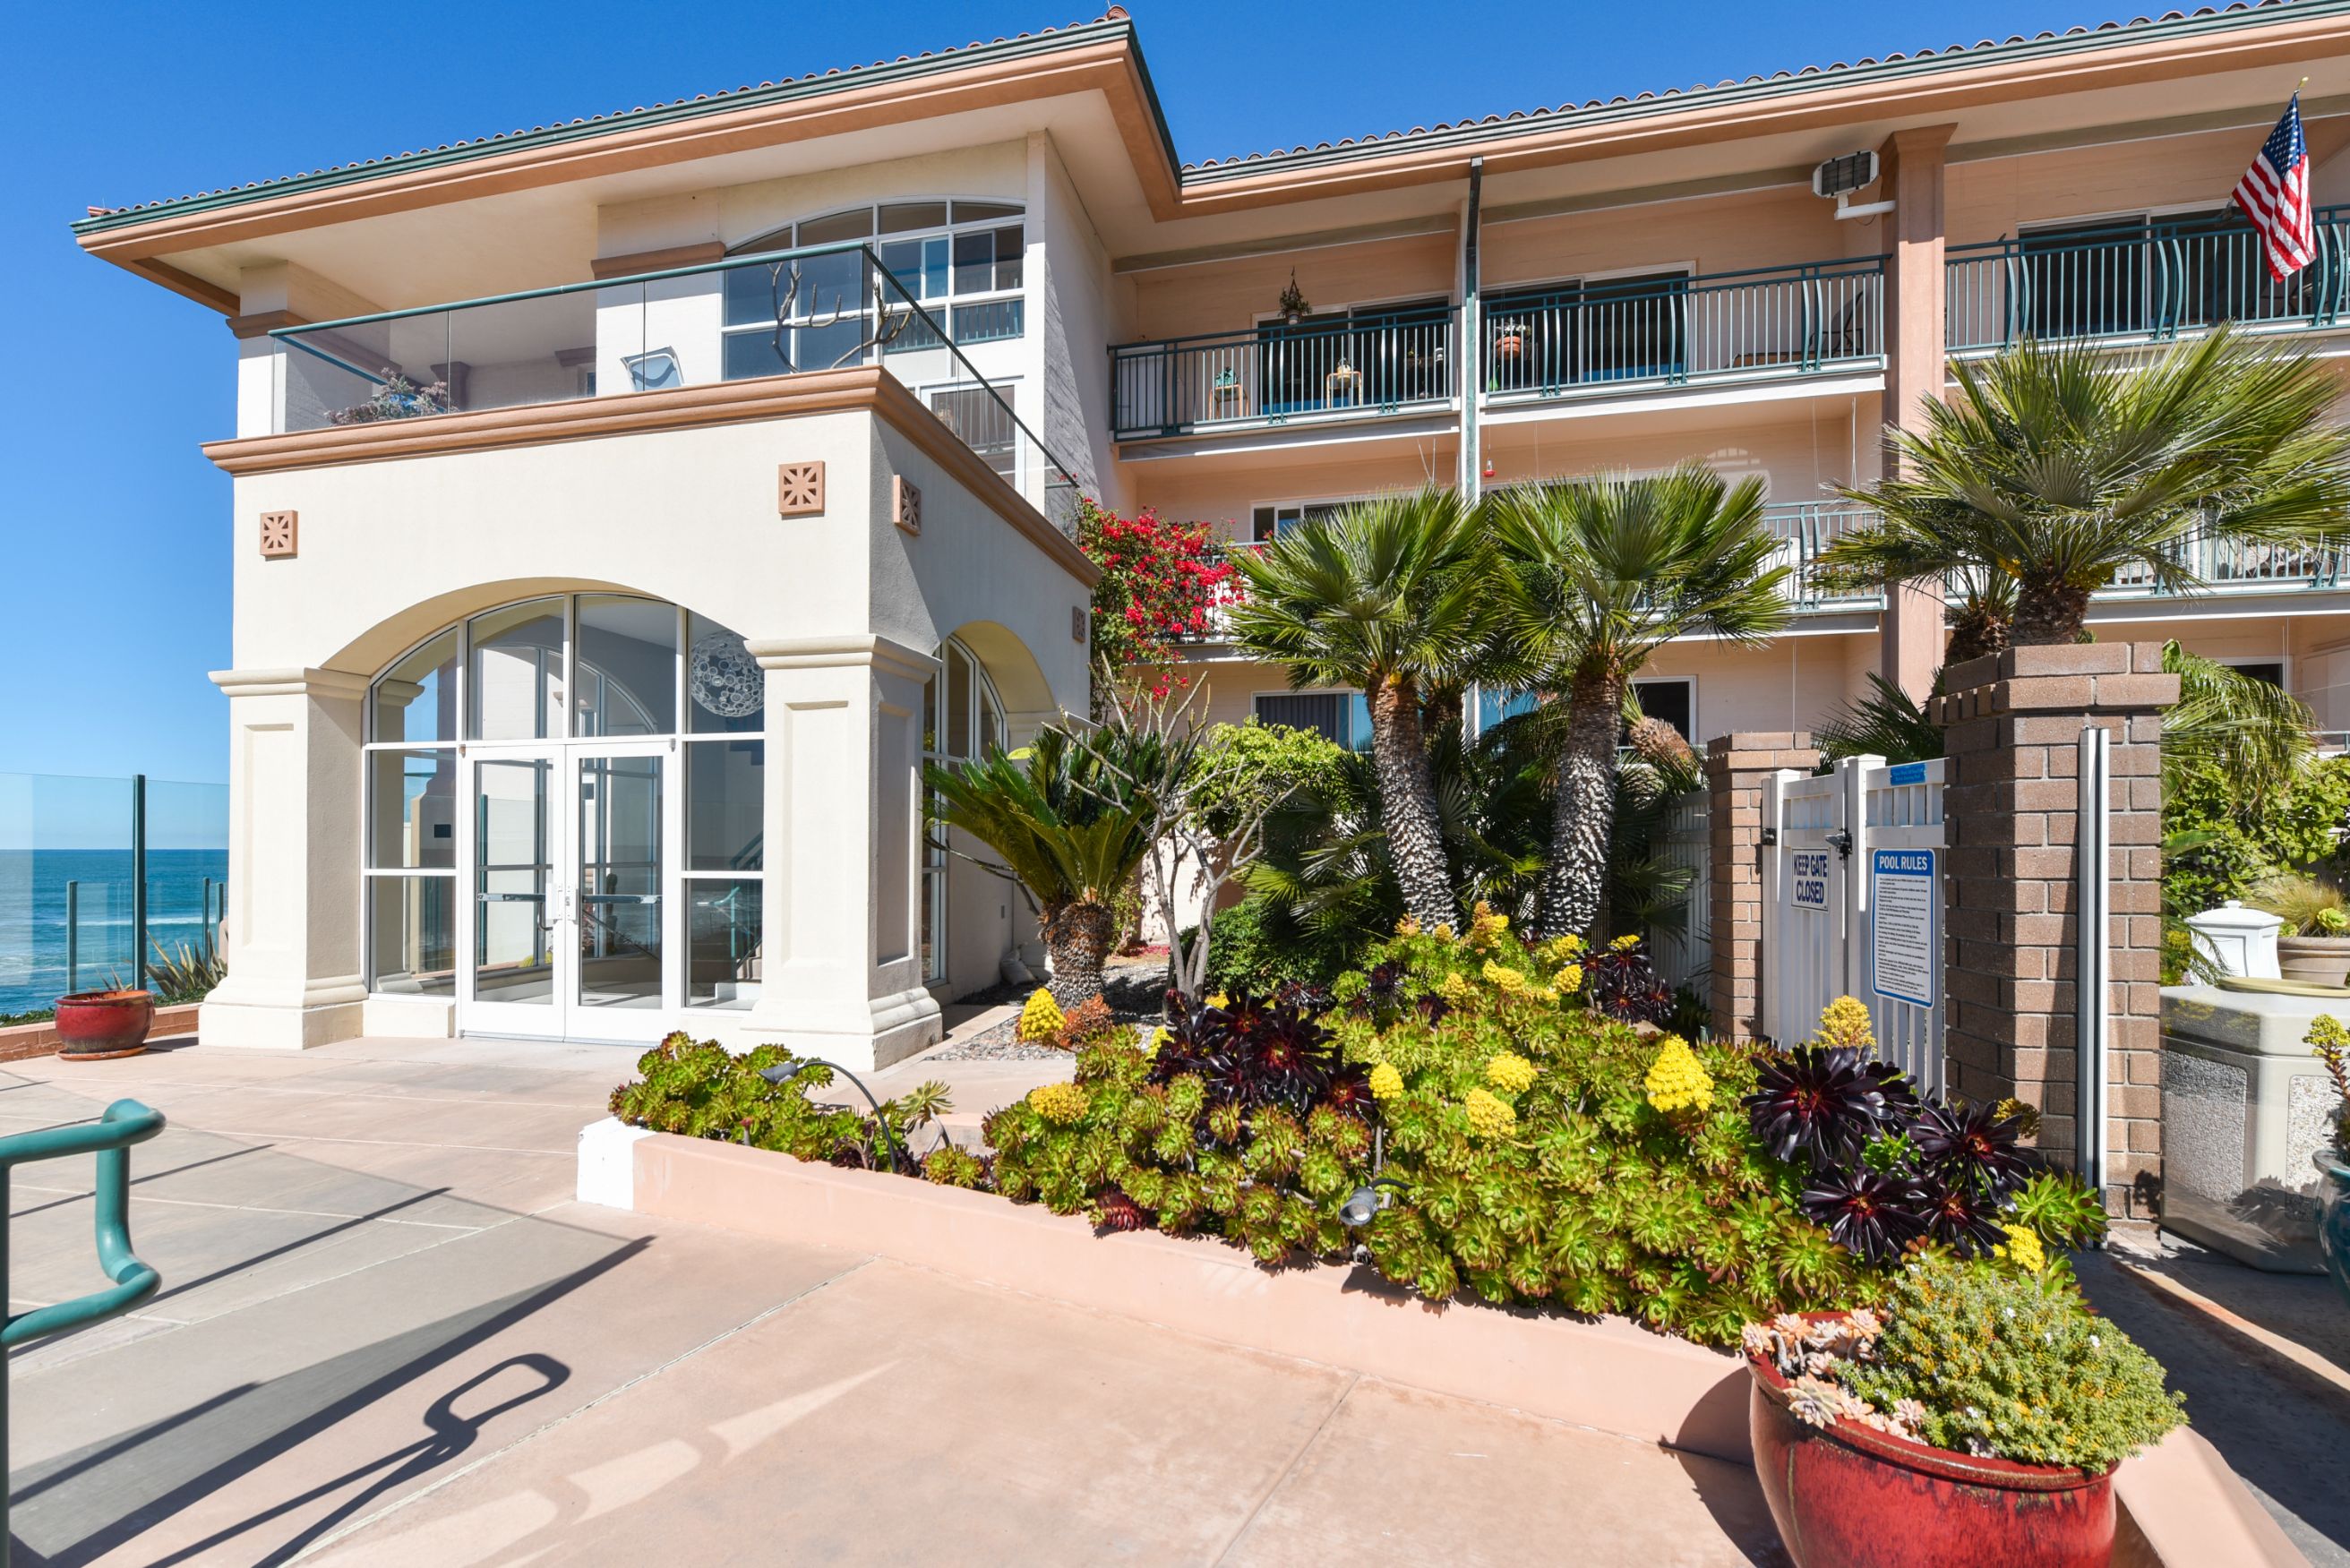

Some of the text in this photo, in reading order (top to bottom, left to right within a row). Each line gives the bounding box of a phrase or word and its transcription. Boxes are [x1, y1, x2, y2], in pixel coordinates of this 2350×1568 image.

[1794, 854, 1827, 878] KEEP GATE
[1879, 855, 1927, 870] POOL RULES
[1797, 879, 1824, 904] CLOSED
